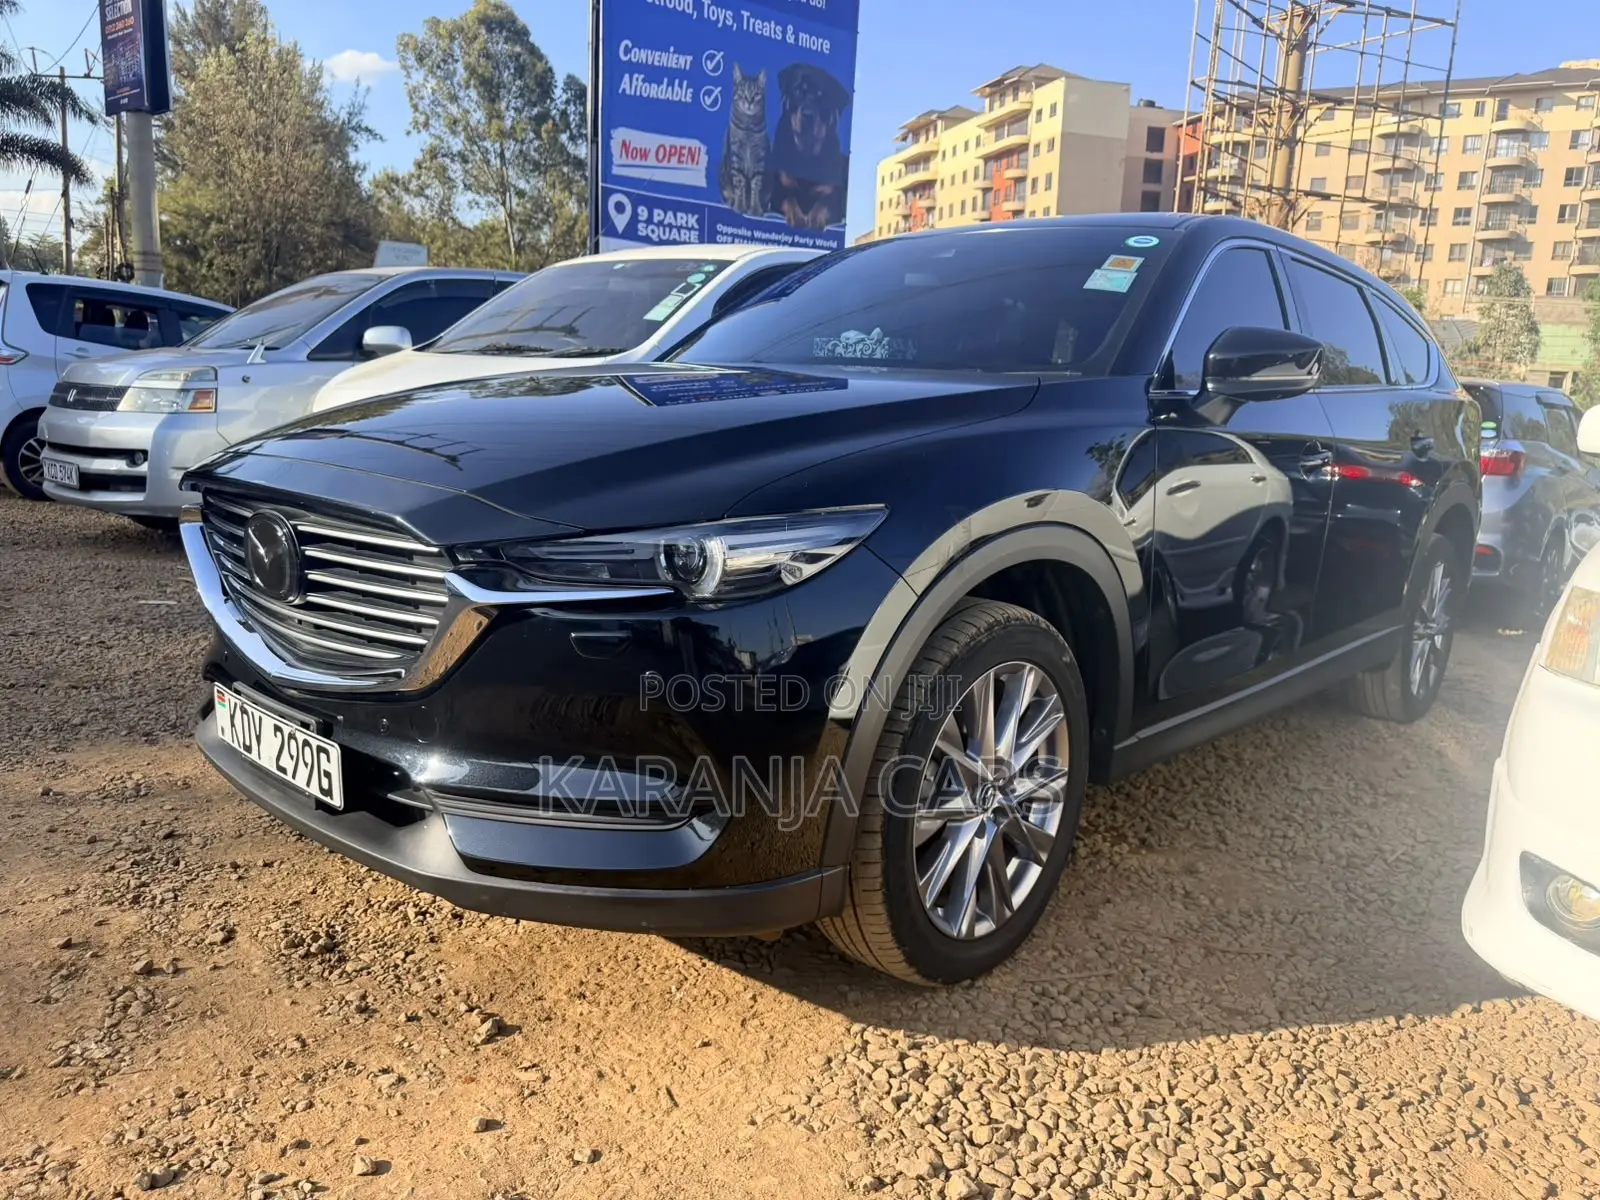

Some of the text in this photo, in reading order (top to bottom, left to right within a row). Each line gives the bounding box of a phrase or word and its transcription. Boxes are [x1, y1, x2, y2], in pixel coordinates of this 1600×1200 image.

[702, 0, 737, 31] Toys,
[741, 10, 782, 41] Treats
[786, 24, 796, 45] &
[799, 31, 831, 54] more
[620, 139, 702, 166] Now OPEN!
[637, 205, 699, 229] 9 PARK
[637, 222, 699, 243] SQUARE
[716, 223, 752, 237] Opposite
[794, 234, 814, 247] Party
[815, 238, 838, 249] World
[228, 697, 334, 801] KDY 299G
